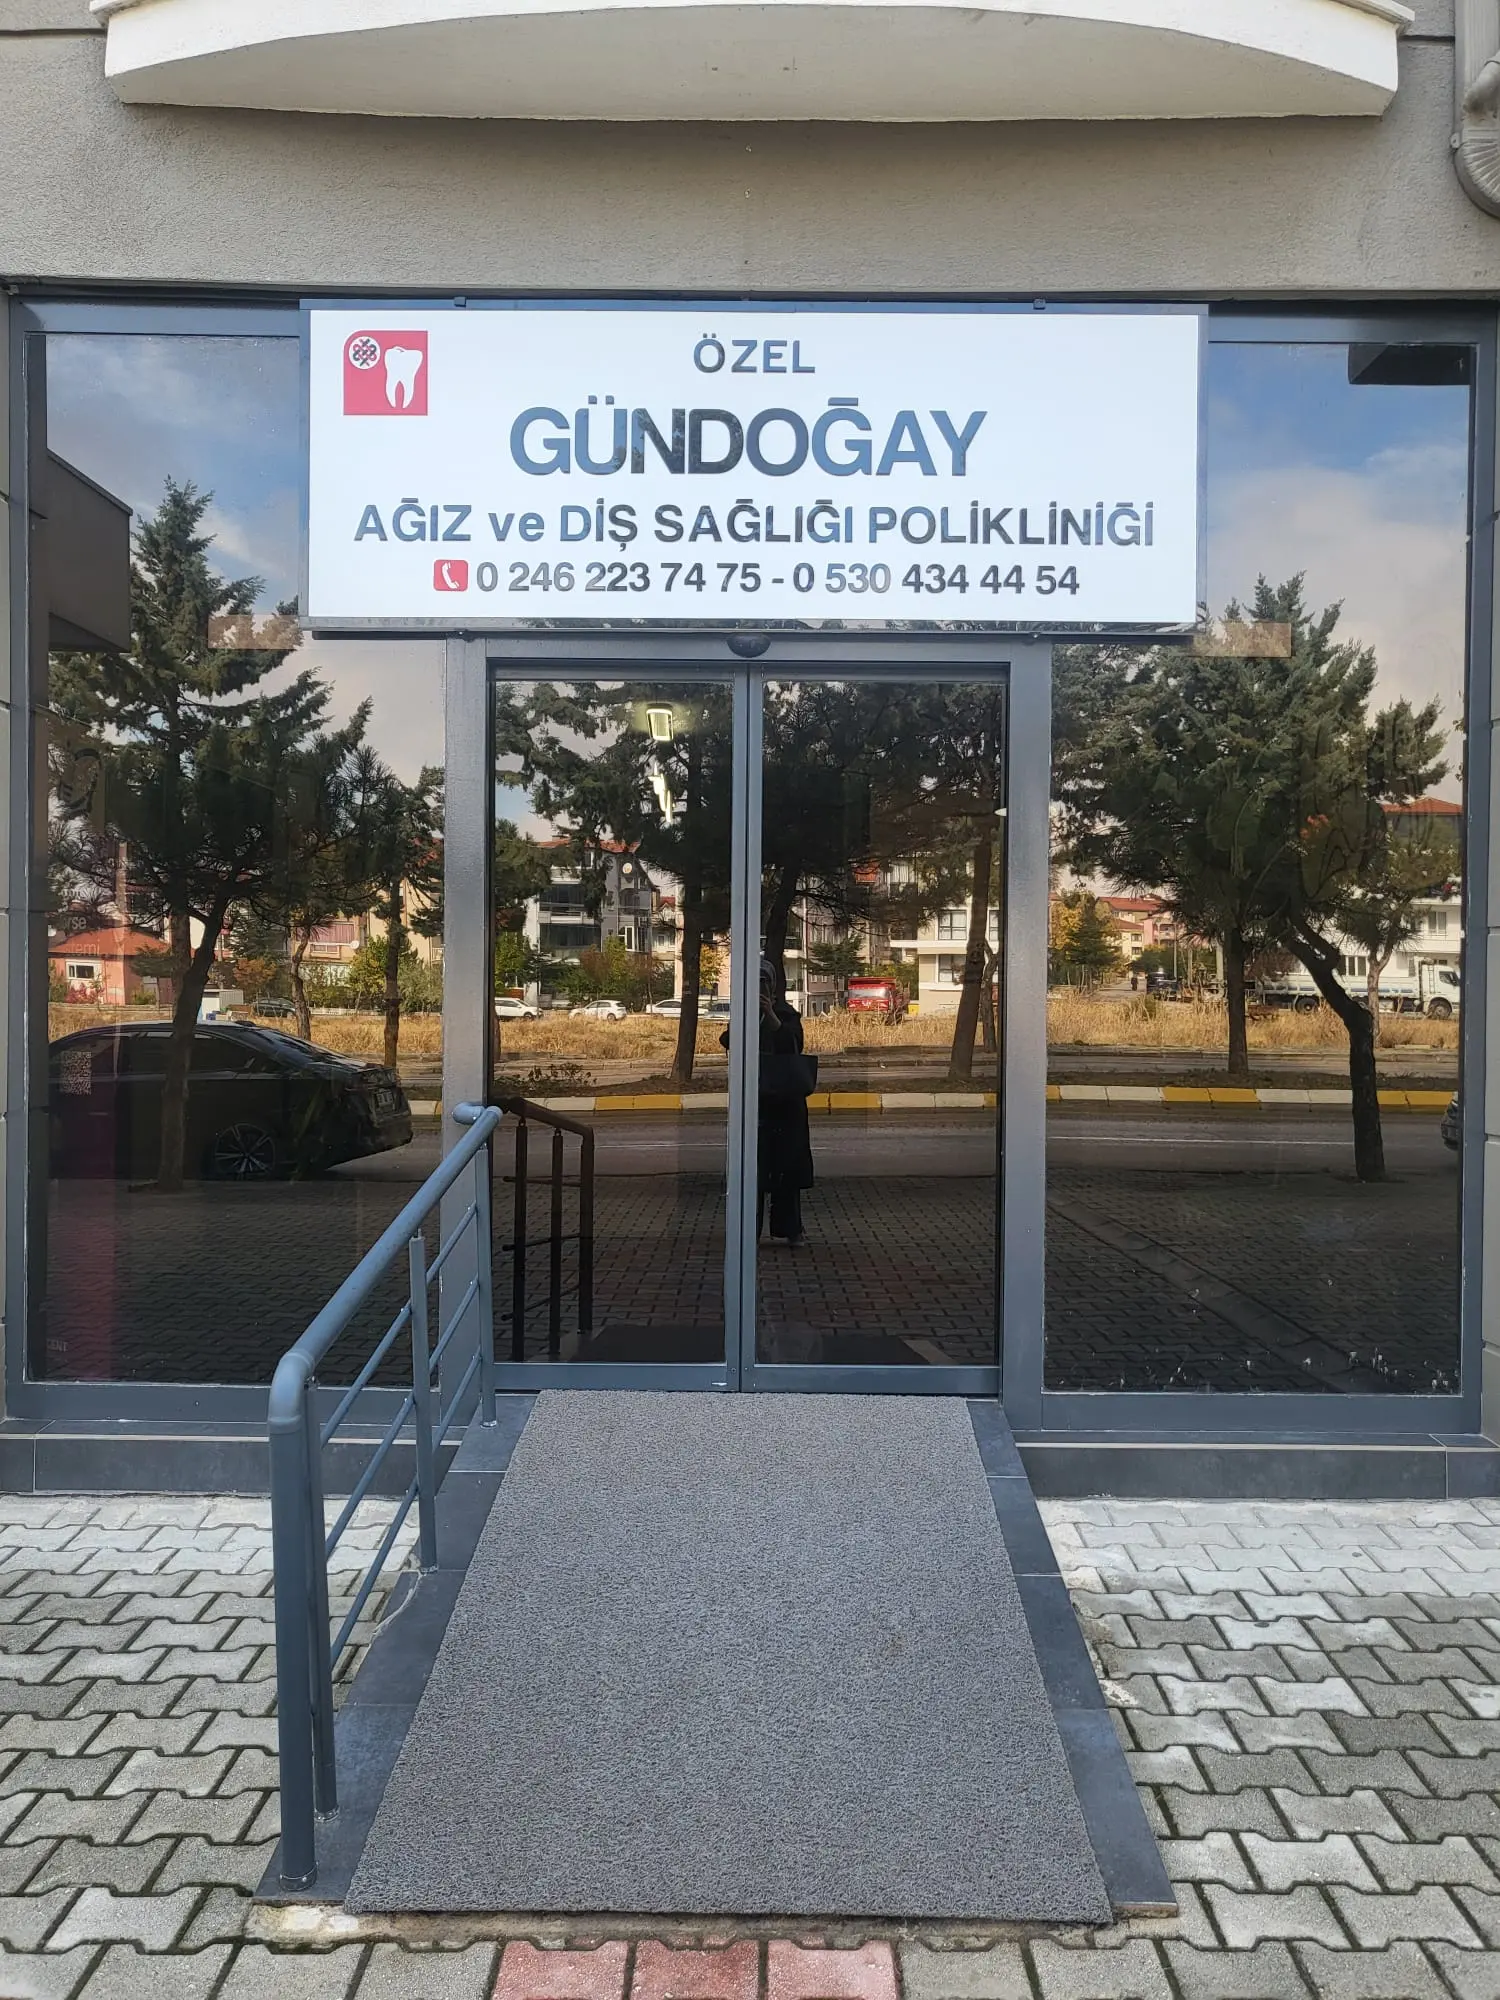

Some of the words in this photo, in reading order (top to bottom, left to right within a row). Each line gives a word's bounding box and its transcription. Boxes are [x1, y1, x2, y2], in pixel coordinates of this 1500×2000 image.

[693, 332, 816, 374] ÖZEL
[509, 394, 988, 477] GÜNDOĞAY
[353, 497, 472, 543] AĞIZ
[487, 512, 545, 543] ve
[559, 497, 638, 553] DİŞ
[653, 498, 853, 544] SAĞLIĞI
[868, 499, 1154, 547] POLİKLİNİĞİ
[476, 561, 499, 592] 0
[508, 561, 575, 592] 246
[584, 561, 651, 593] 223
[660, 562, 707, 593] 74
[716, 562, 762, 593] 75
[771, 576, 785, 584] -
[792, 562, 815, 593] 0
[824, 562, 892, 594] 530
[901, 563, 970, 594] 434
[979, 564, 1026, 595] 44
[1035, 565, 1081, 596] 54
